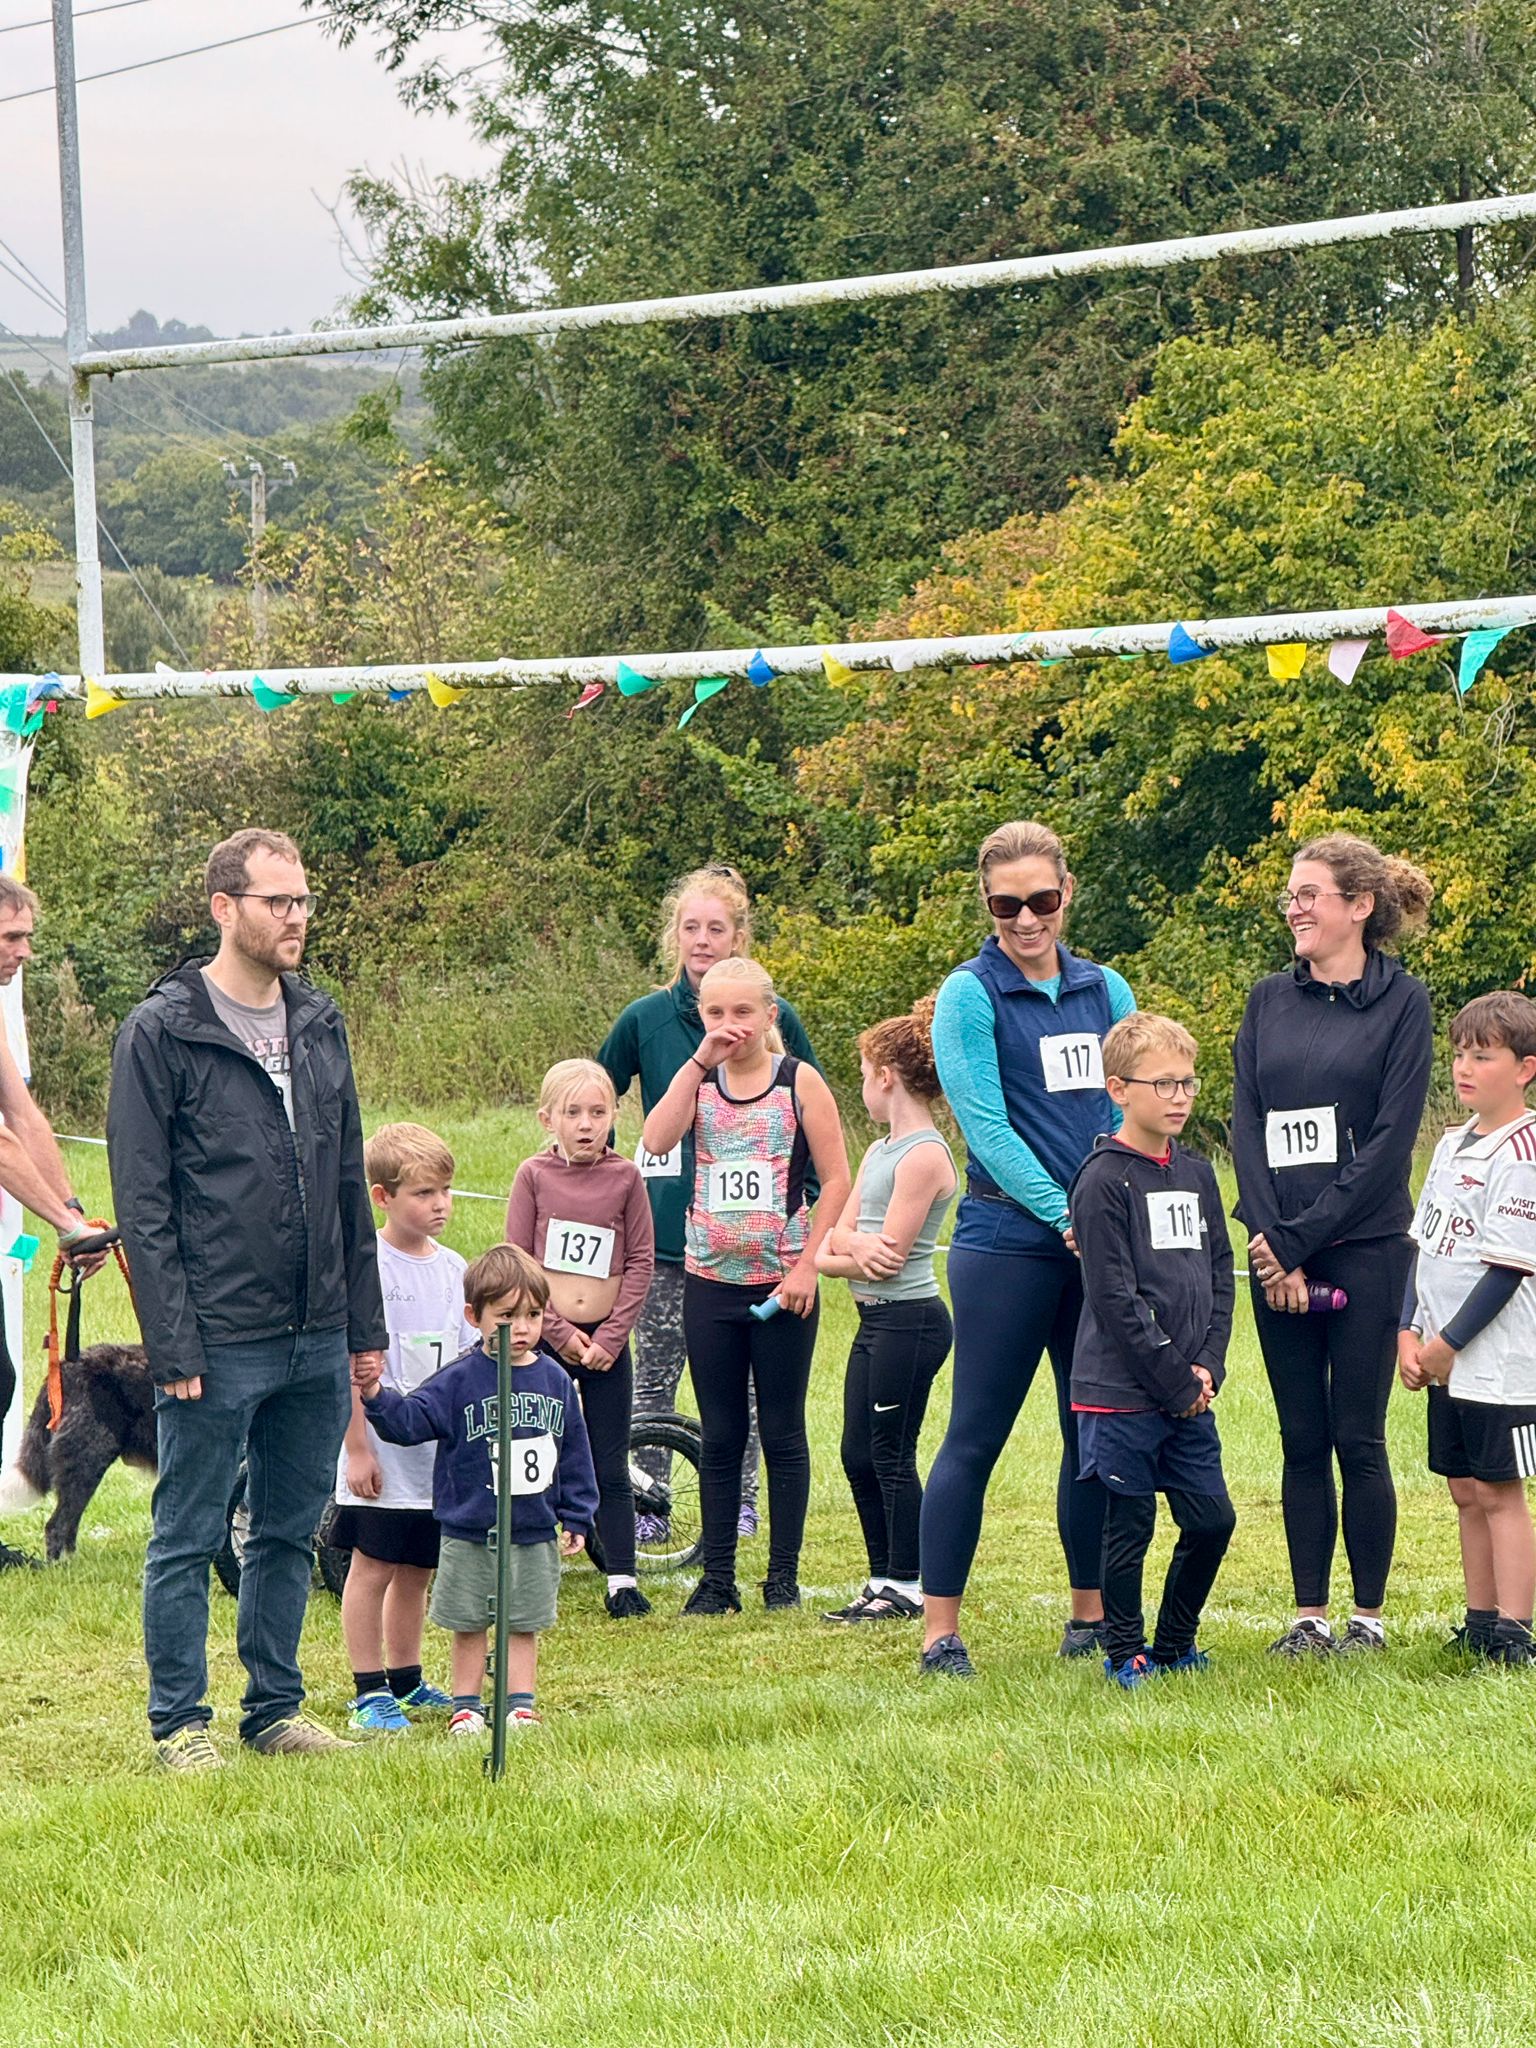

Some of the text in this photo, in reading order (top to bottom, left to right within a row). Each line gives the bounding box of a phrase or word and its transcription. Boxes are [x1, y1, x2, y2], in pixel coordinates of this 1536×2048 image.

[1060, 1045, 1090, 1078] 117
[1281, 1120, 1318, 1155] 119
[719, 1170, 760, 1201] 136
[1497, 1204, 1536, 1221] RWAND
[1510, 1196, 1536, 1210] VISIT
[1167, 1203, 1194, 1238] 116
[560, 1231, 602, 1266] 137
[429, 1341, 442, 1371] 7
[523, 1449, 540, 1483] 8
